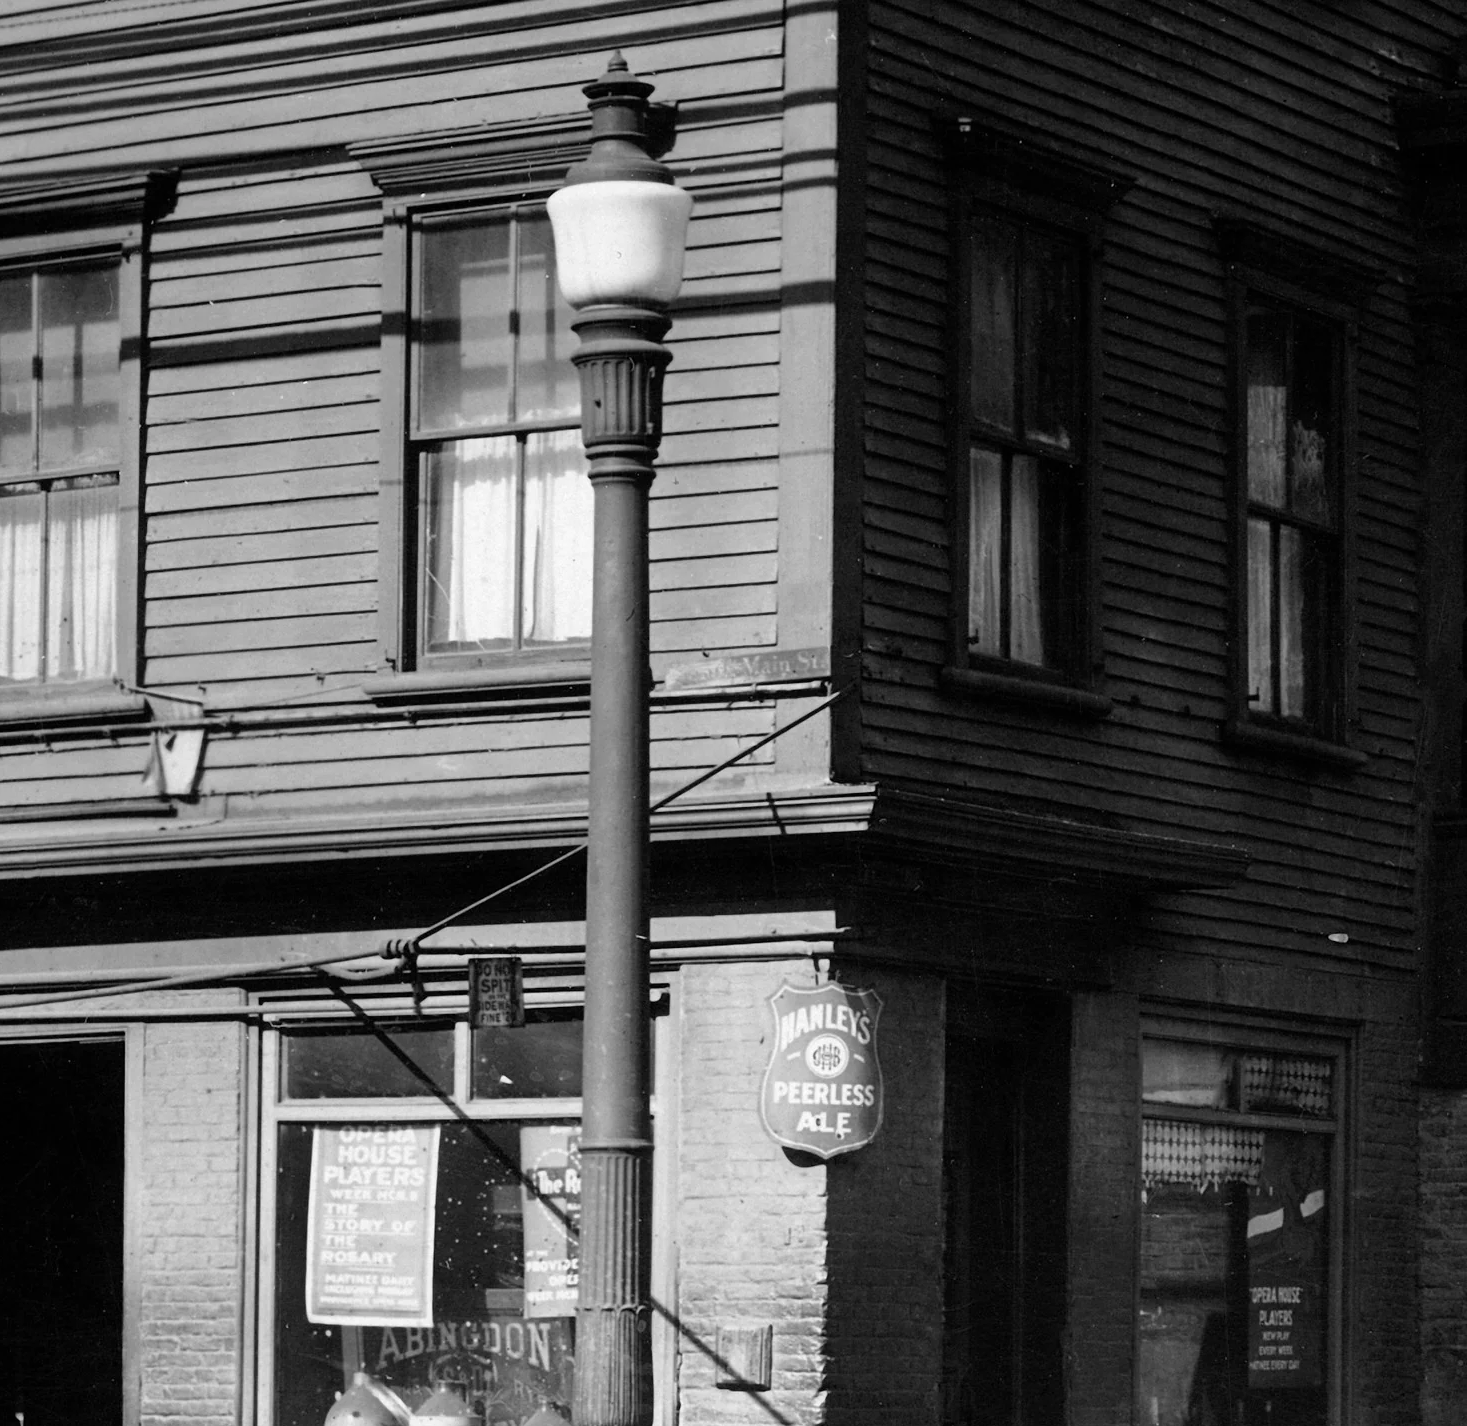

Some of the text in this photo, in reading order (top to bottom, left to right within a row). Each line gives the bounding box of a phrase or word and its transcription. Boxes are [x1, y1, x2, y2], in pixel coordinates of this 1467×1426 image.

[481, 979, 510, 993] SPIT
[780, 1003, 870, 1052] HANLEY'S
[773, 1081, 875, 1106] PEERLESS
[796, 1111, 852, 1134] ALE
[338, 1125, 417, 1143] OPERA
[337, 1145, 417, 1165] HOUSE
[323, 1166, 426, 1187] PLAYERS
[538, 1170, 563, 1194] The
[329, 1189, 373, 1200] WEEK
[323, 1203, 359, 1216] THE
[324, 1218, 418, 1234] STORY OF
[321, 1235, 356, 1247] THE
[319, 1250, 397, 1264] ROSARY
[526, 1259, 579, 1272] PROVIDE
[1259, 1309, 1293, 1327] PLAYERS
[375, 1322, 552, 1373] ABINGDON
